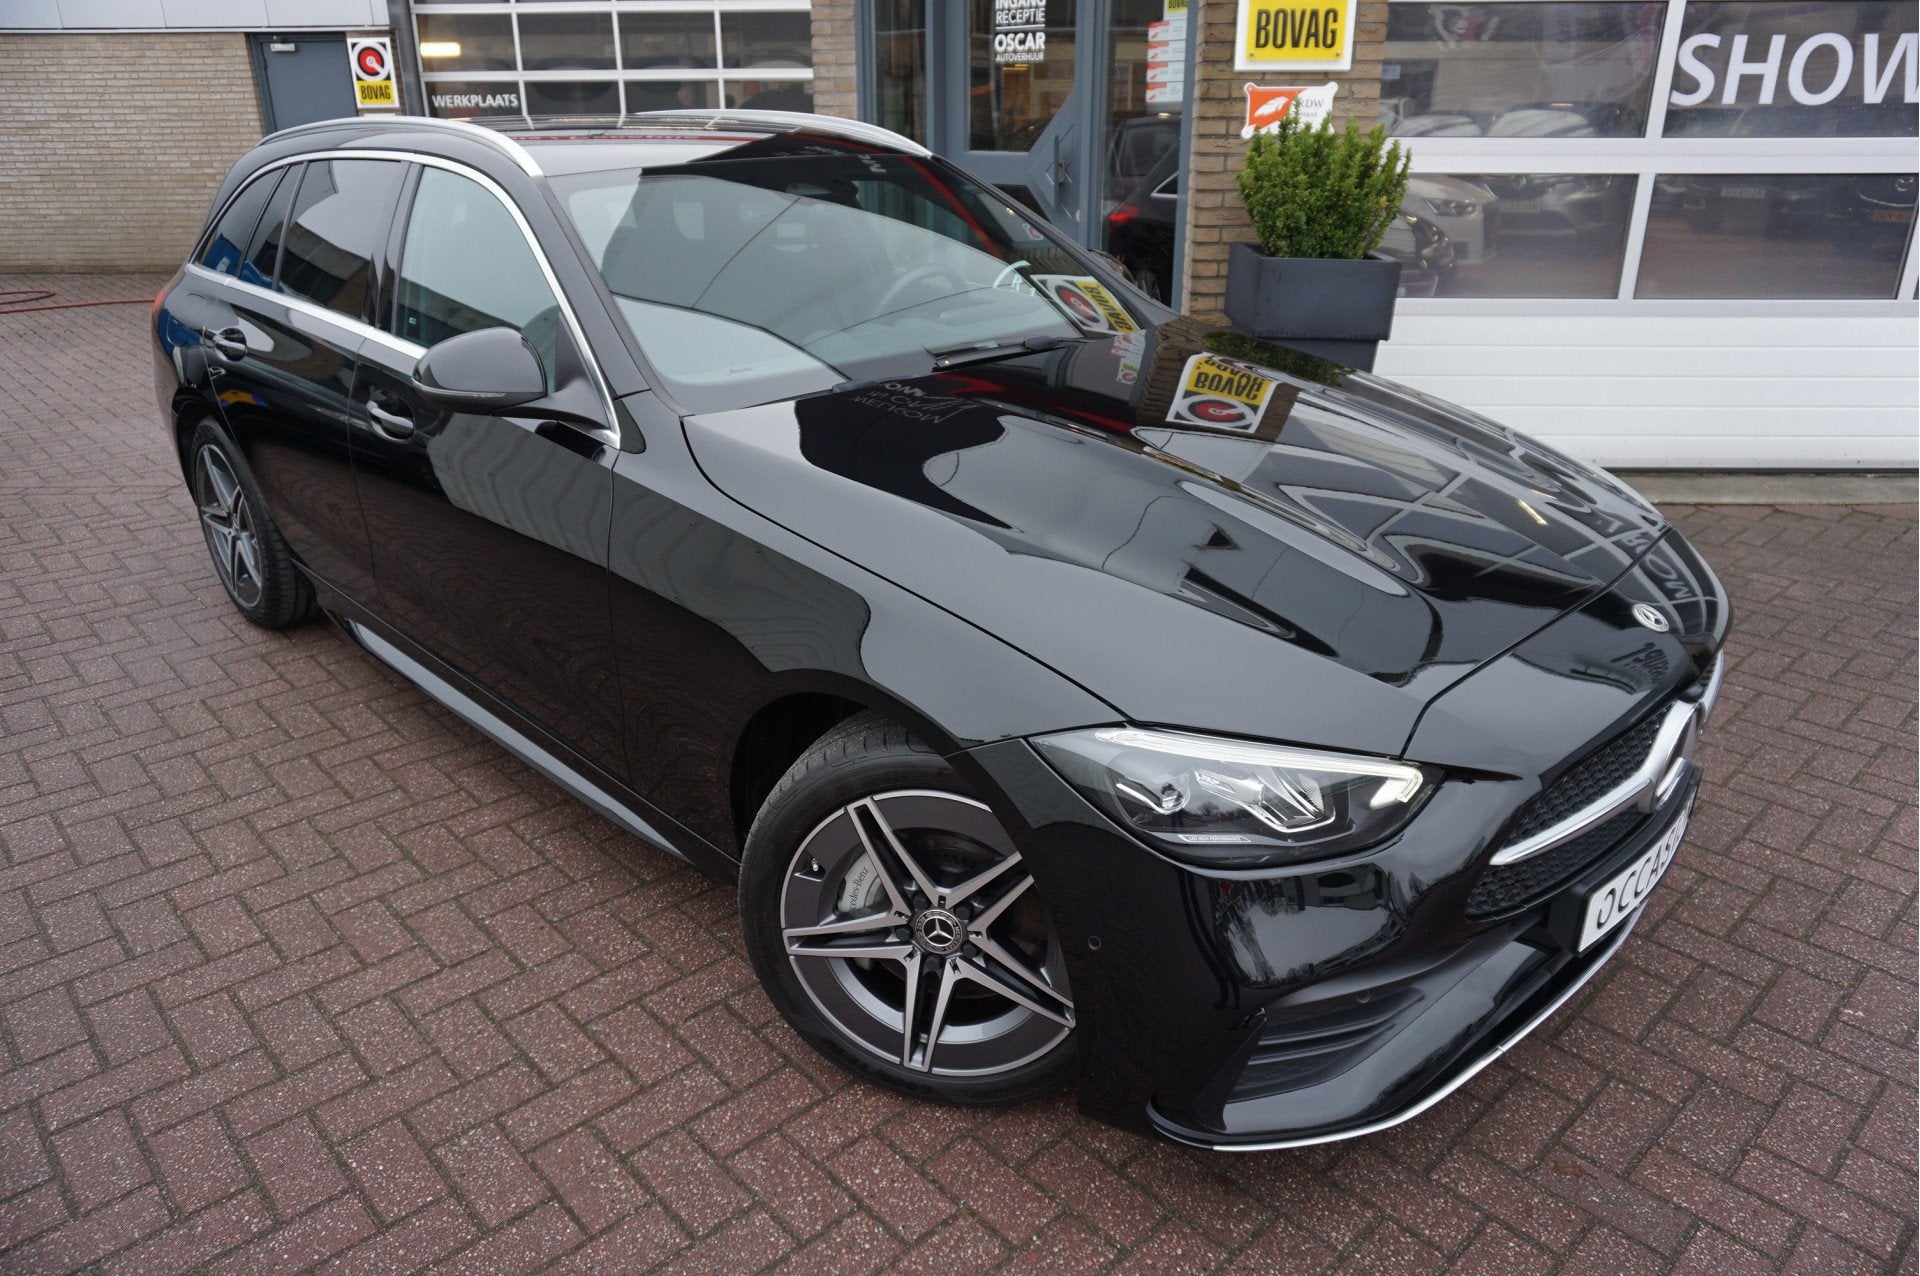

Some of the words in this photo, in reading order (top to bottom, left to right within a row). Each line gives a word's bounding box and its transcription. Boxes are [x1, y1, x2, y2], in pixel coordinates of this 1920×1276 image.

[996, 8, 1046, 24] RECEPTIE
[1255, 8, 1339, 49] BOVAG
[994, 32, 1047, 52] OSCAR
[995, 52, 1044, 62] AUTOVERHUUR
[361, 85, 391, 100] BOVAG
[432, 94, 518, 107] WERKPLAATS
